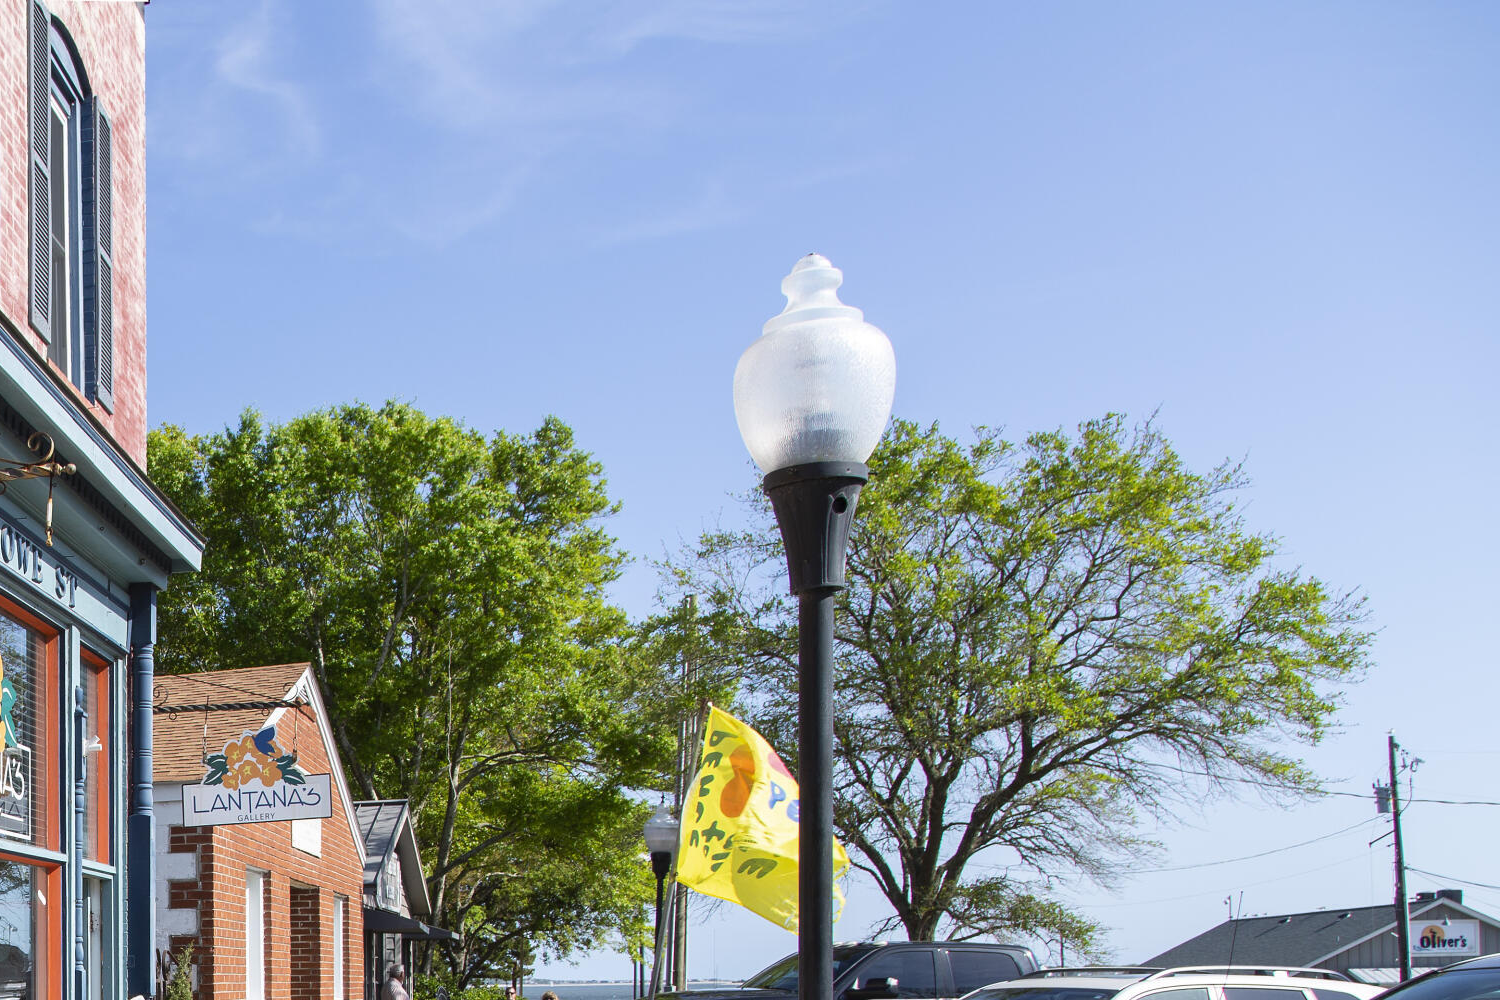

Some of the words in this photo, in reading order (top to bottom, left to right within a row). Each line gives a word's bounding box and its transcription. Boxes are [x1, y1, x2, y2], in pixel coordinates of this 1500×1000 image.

[54, 564, 78, 609] ST
[193, 785, 321, 814] LANTANA'S
[237, 812, 276, 822] GALLERY
[1420, 930, 1467, 949] Oliver's
